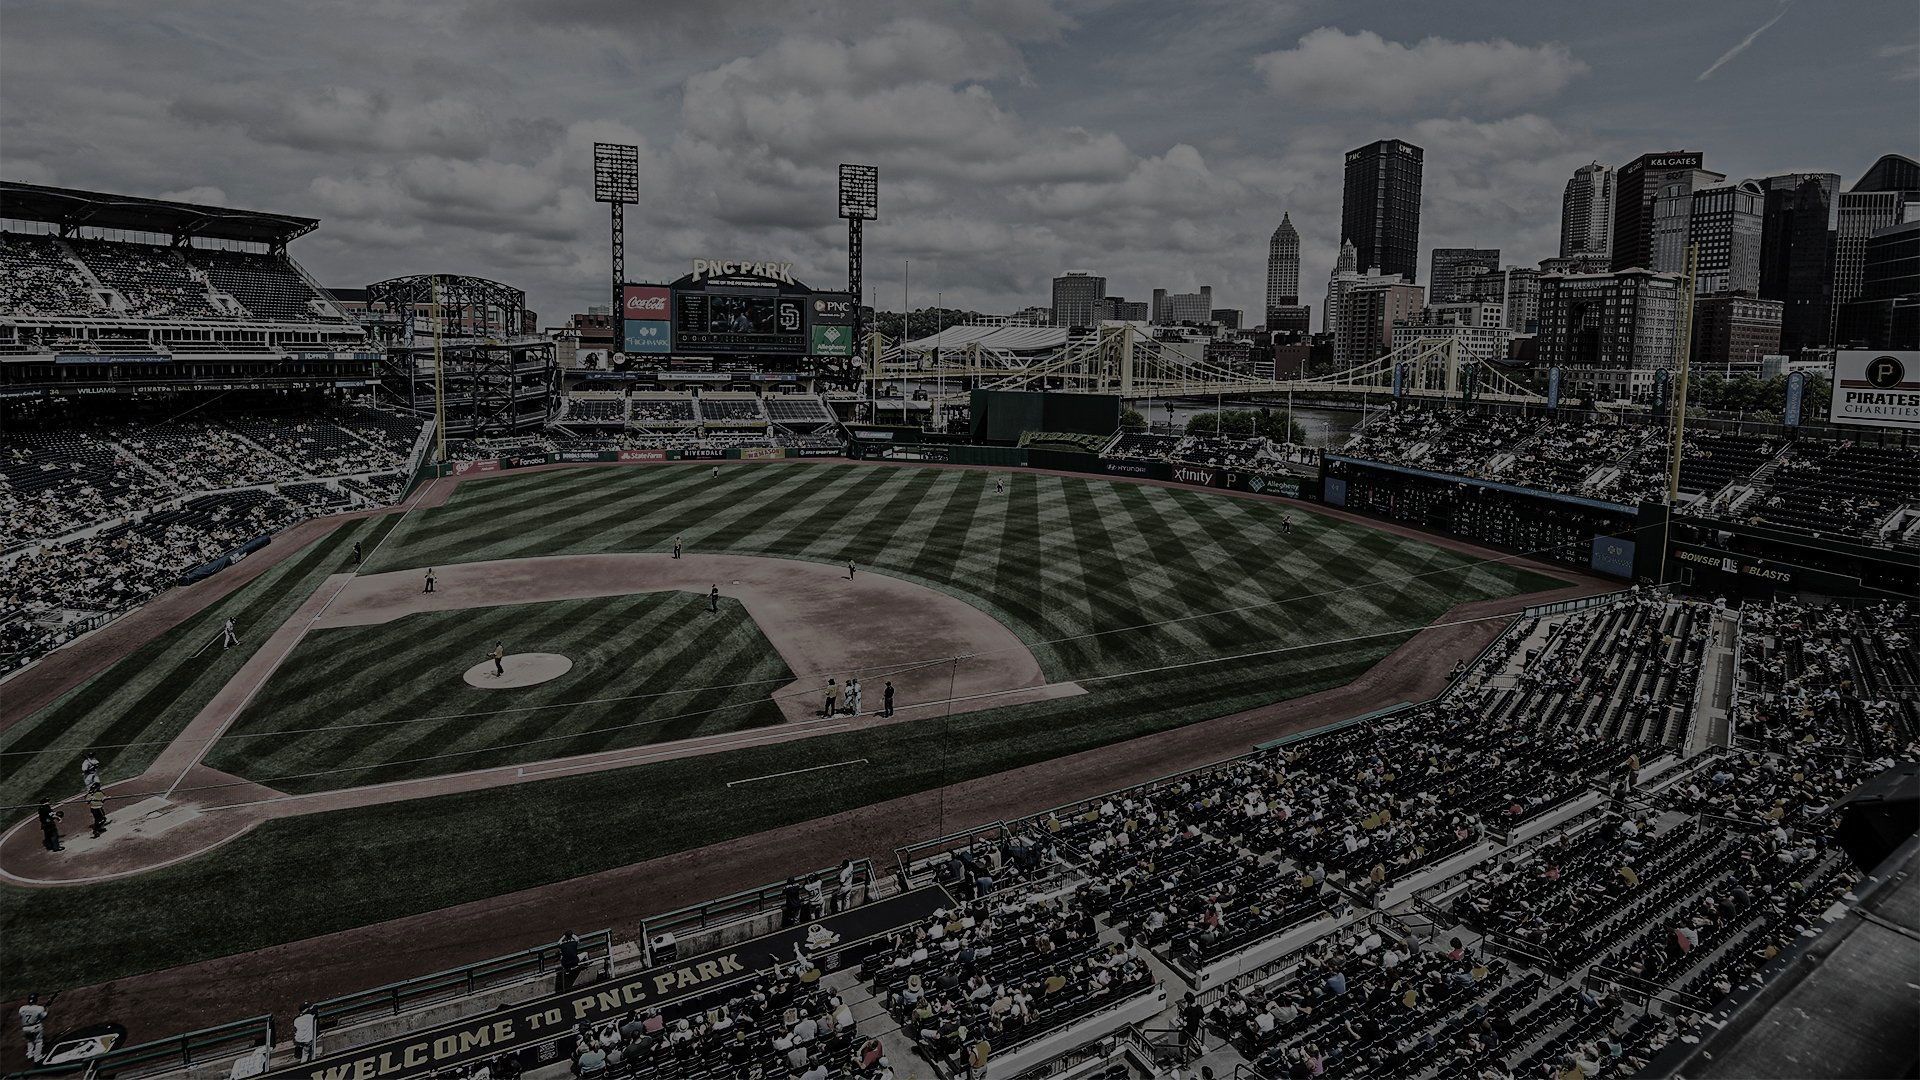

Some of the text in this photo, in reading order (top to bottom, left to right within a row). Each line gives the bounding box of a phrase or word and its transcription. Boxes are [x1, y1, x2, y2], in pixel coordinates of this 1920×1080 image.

[1668, 157, 1697, 165] GATES
[692, 258, 796, 286] PNC PARK
[827, 301, 850, 312] PNC
[1877, 363, 1894, 383] P
[1846, 391, 1920, 407] PIRATES
[1844, 404, 1919, 417] CHARITIES
[520, 457, 546, 466] Fanatics
[1174, 468, 1213, 485] xfinity
[1226, 473, 1237, 488] P
[1267, 480, 1299, 491] Allegheny
[1680, 551, 1720, 567] BOWSER
[1749, 566, 1791, 582] BLASTS
[310, 1019, 516, 1080] WELCOME
[525, 1007, 563, 1031] TO
[571, 981, 647, 1020] PNC
[652, 953, 745, 995] PARK
